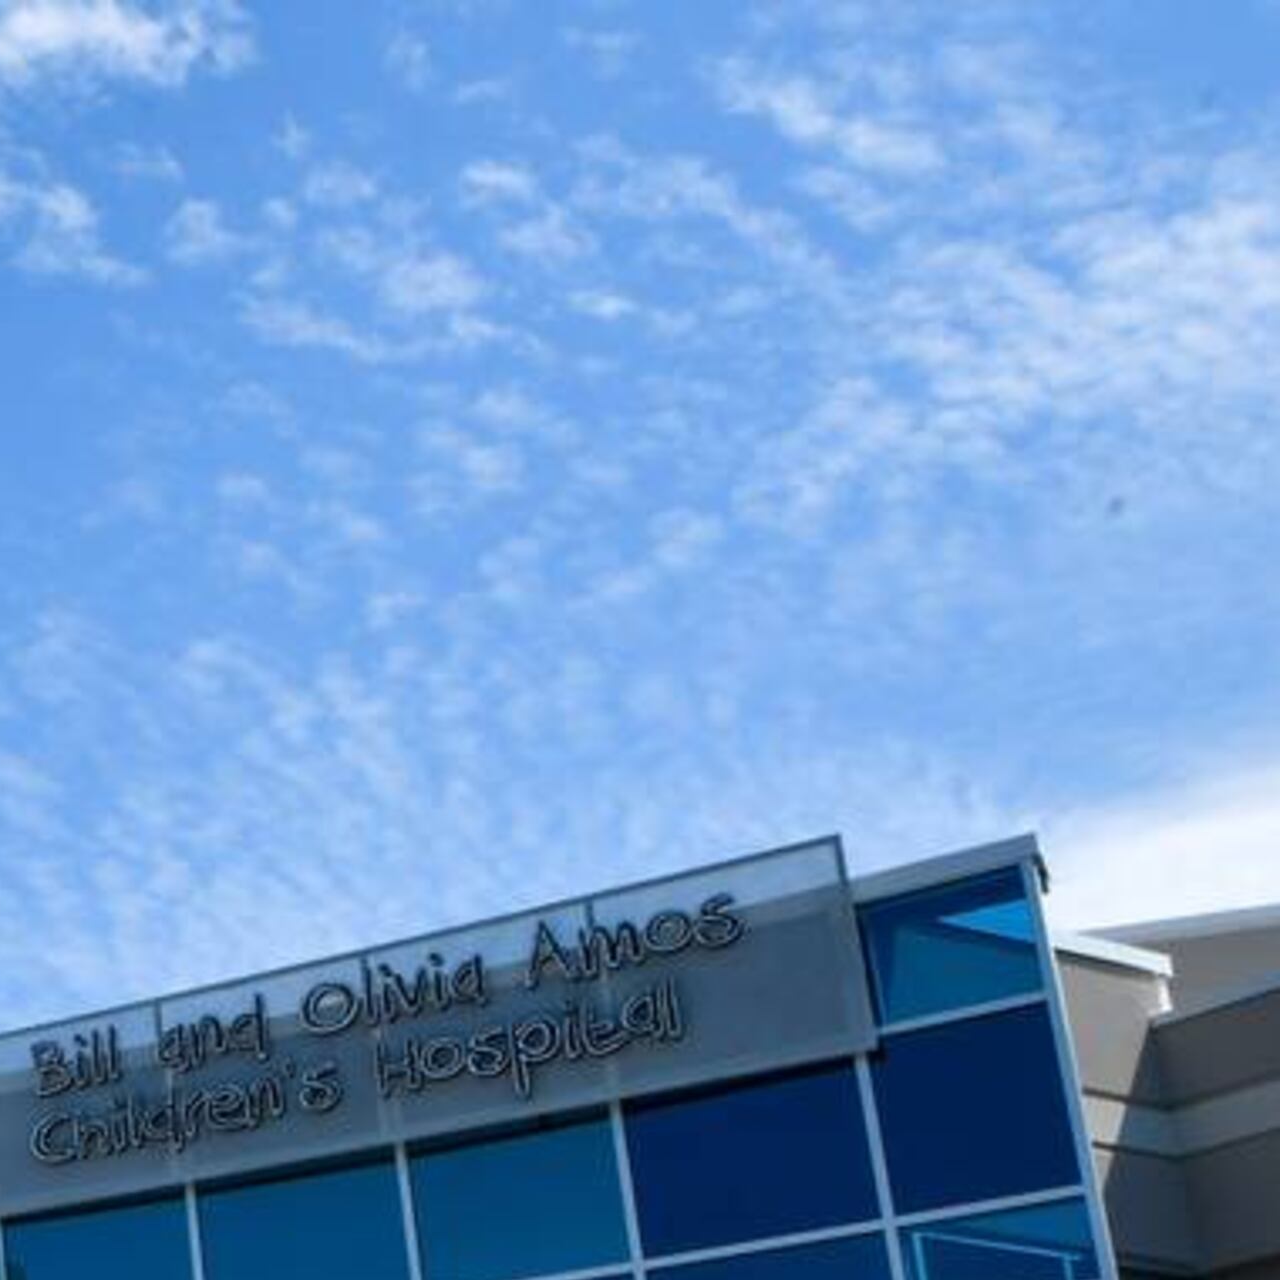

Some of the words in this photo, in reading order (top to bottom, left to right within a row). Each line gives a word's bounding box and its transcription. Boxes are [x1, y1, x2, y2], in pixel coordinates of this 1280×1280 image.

[30, 1022, 123, 1098] Bill
[156, 992, 269, 1073] and
[300, 951, 487, 1036] Olivia
[525, 893, 743, 989] Amos
[30, 1056, 342, 1165] Children's
[374, 974, 685, 1099] Hospital
